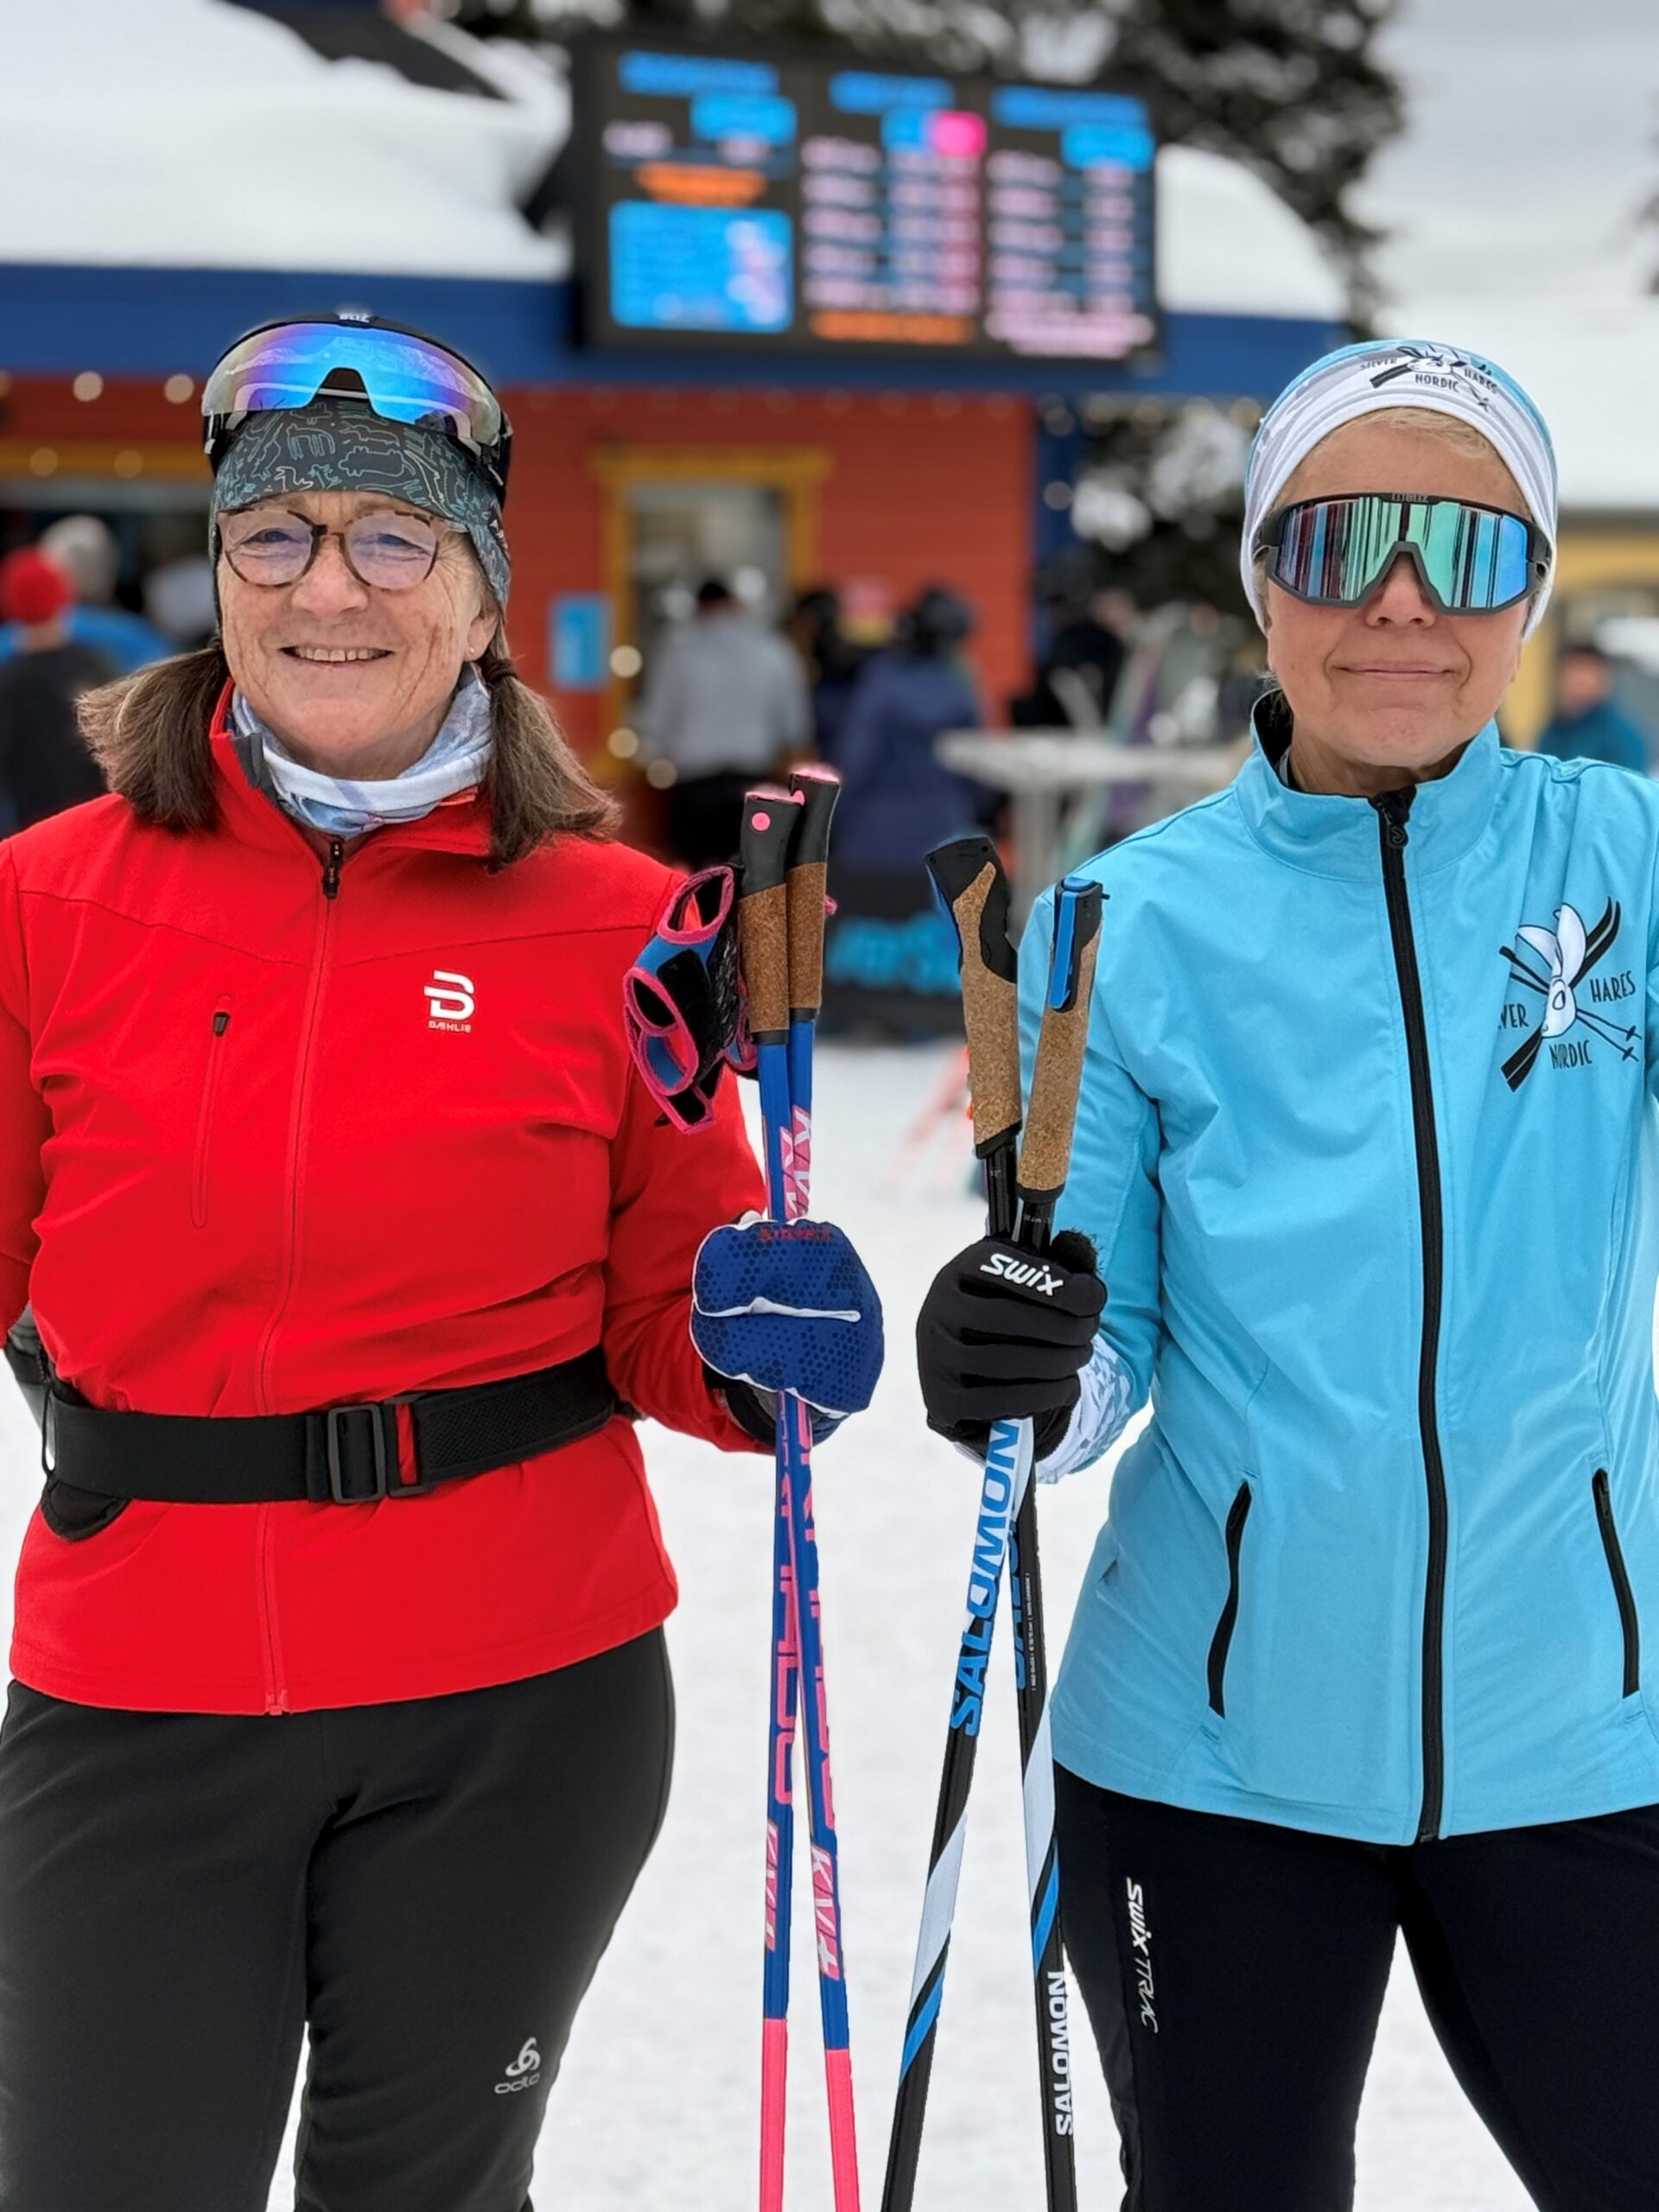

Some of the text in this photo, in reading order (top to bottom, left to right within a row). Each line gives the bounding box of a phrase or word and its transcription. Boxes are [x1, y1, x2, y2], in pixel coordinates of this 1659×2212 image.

[1414, 373, 1459, 393] NORDIC
[1589, 969, 1636, 1003] HARES
[950, 1418, 1020, 1738] SALOMON
[1047, 1971, 1073, 2137] SALOMON
